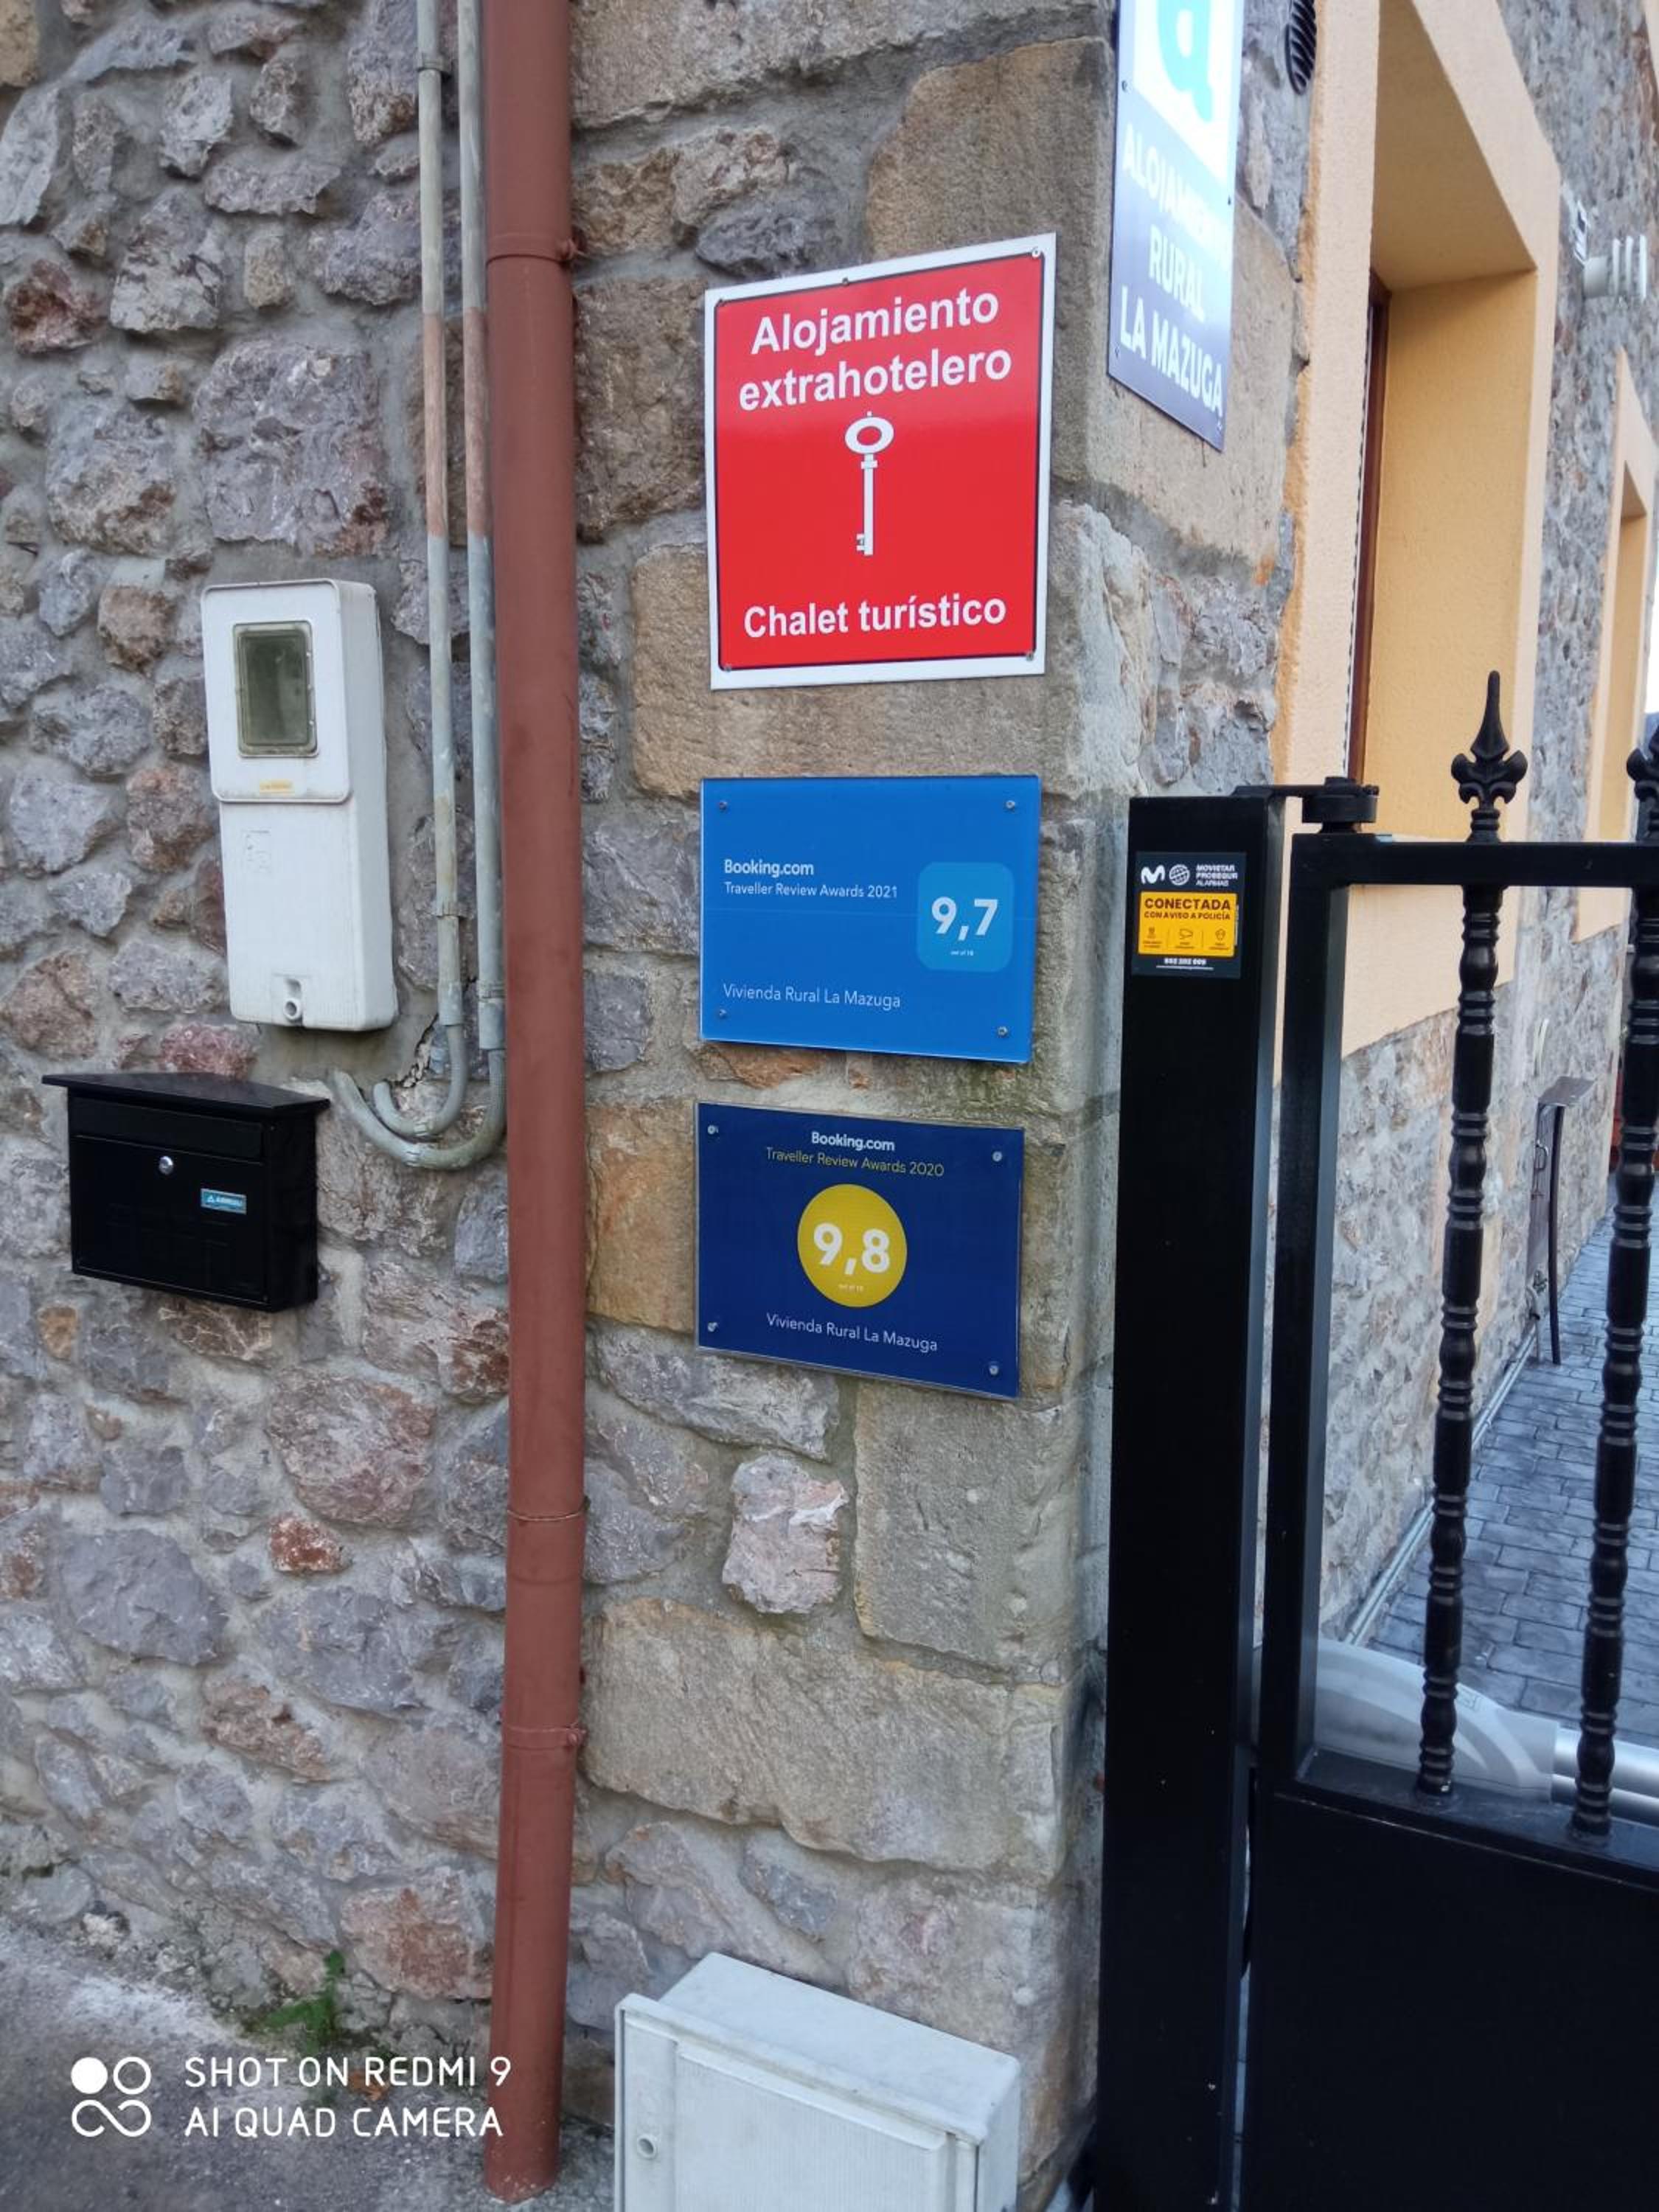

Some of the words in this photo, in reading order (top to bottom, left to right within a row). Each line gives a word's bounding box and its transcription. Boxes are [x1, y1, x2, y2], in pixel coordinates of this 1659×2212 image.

[1148, 223, 1206, 323] RURAL
[751, 288, 1000, 357] Alojamiento
[1119, 285, 1147, 360] LA
[1150, 309, 1225, 418] MAZUGA
[739, 347, 1012, 411] extrahotelero
[743, 602, 849, 639] Chalet
[858, 592, 1006, 632] turístico
[723, 858, 814, 878] Booking.com
[724, 880, 773, 896] Traveller
[776, 883, 818, 897] Review
[820, 884, 864, 898] Awards
[867, 885, 898, 899] 2021
[1144, 897, 1231, 911] CONECTADA
[931, 895, 999, 942] 9,7
[1144, 911, 1162, 919] CON
[723, 983, 782, 1002] Vivienda
[785, 986, 821, 1004] Rural
[824, 988, 841, 1005] La
[844, 990, 902, 1011] Mazuga
[766, 1146, 814, 1164] Traveller
[817, 1152, 858, 1169] Review
[861, 1157, 906, 1174] Awards
[908, 1161, 945, 1178] 2020
[811, 1131, 896, 1152] Booking.com
[813, 1222, 891, 1276] 9,8
[766, 1312, 823, 1334] Vivienda
[826, 1322, 861, 1340] Rural
[863, 1327, 880, 1343] La
[883, 1332, 939, 1354] Mazuga
